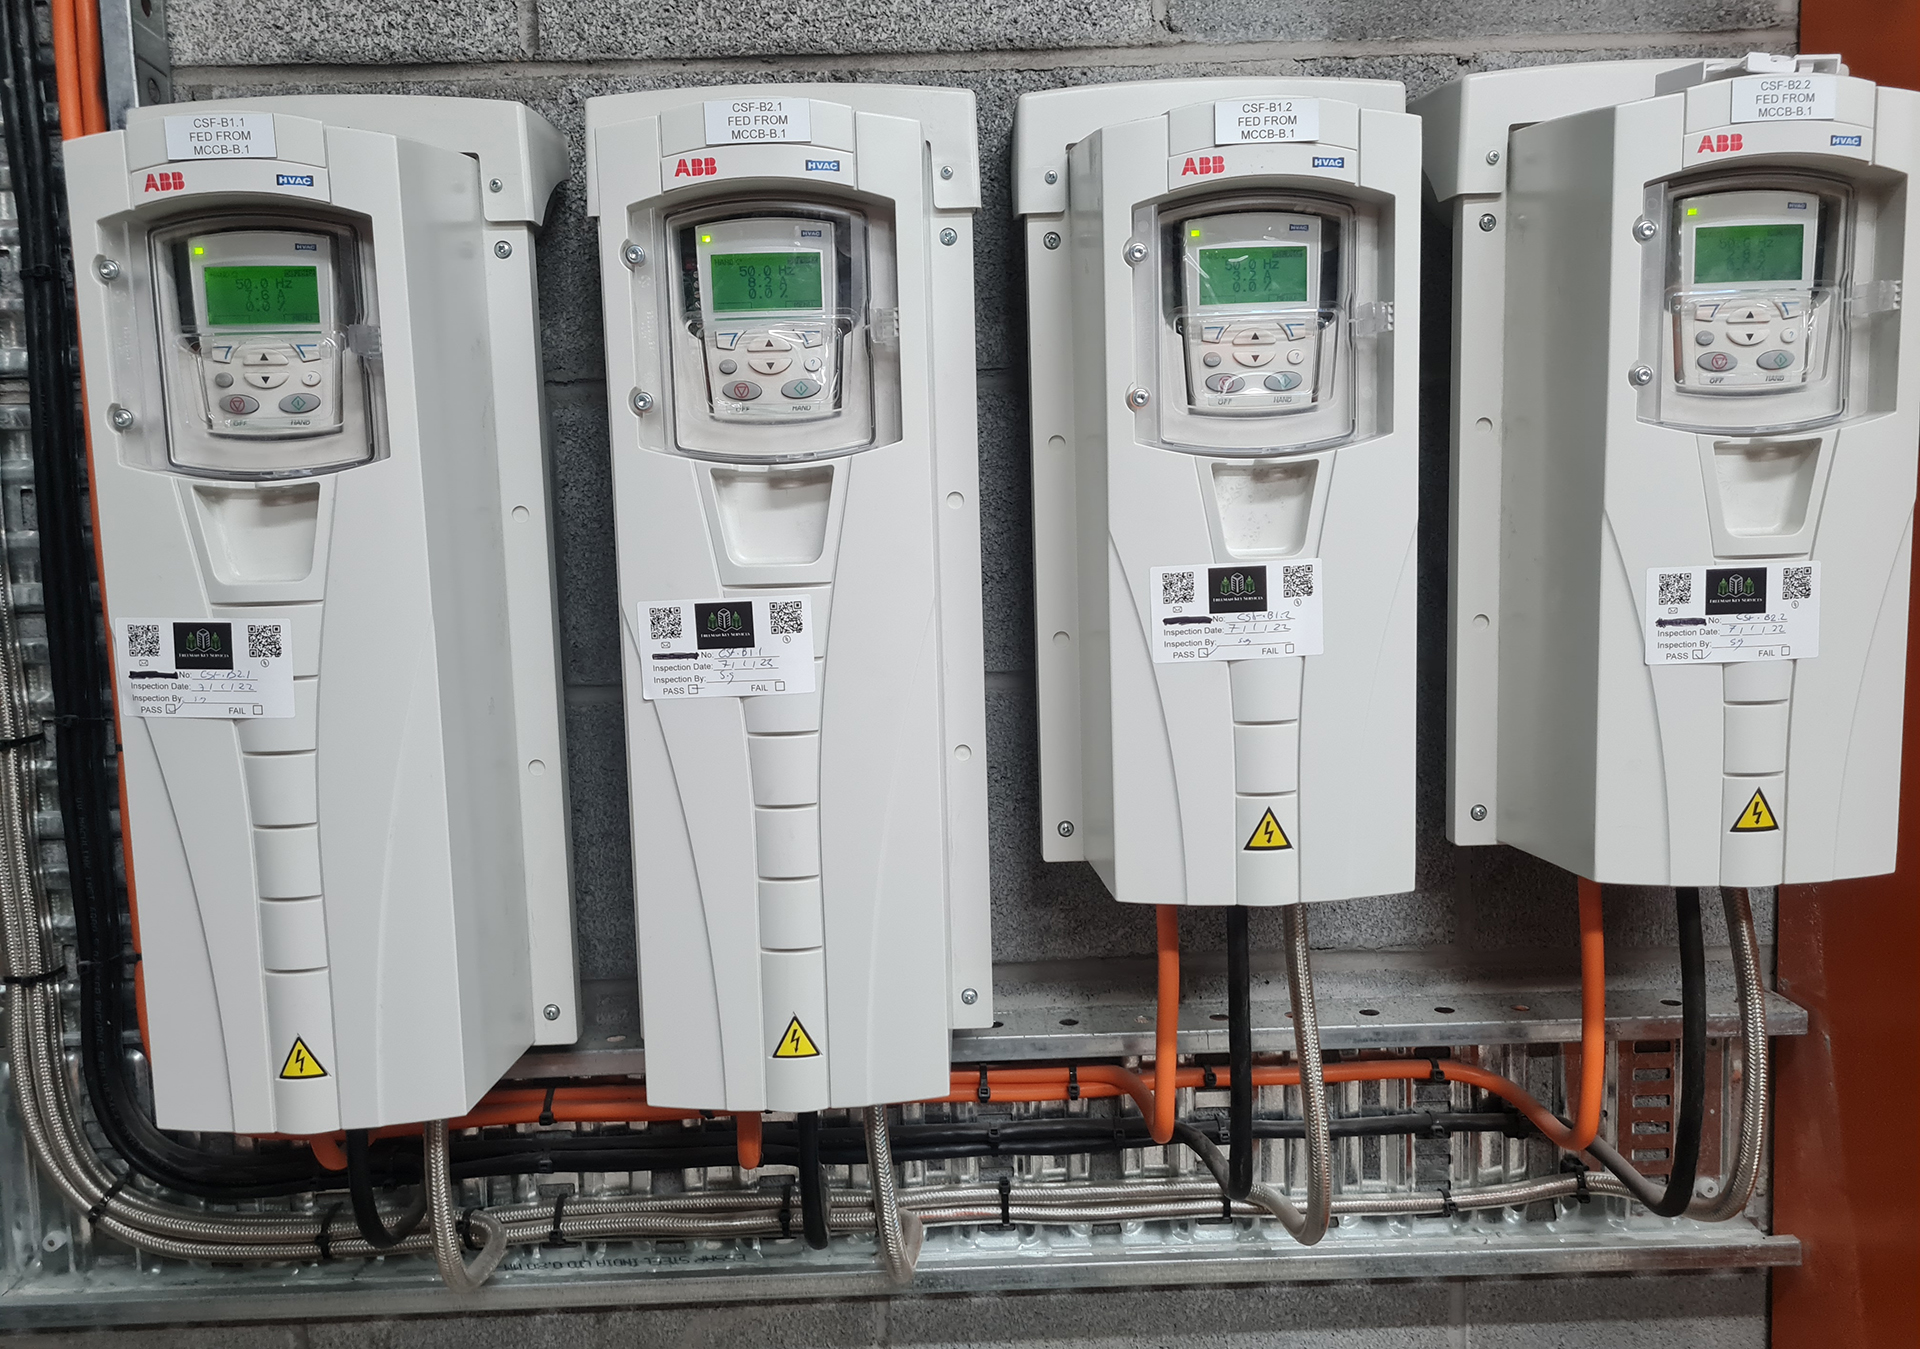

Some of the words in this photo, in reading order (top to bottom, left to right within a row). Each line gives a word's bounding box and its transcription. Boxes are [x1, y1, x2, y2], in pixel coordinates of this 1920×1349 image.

[1760, 80, 1811, 91] CSF-B2.2
[1756, 94, 1779, 105] FED
[1782, 92, 1815, 103] FROM
[732, 102, 782, 113] CSF-B2.1
[1242, 102, 1292, 113] CSF-B1.2
[1758, 106, 1812, 118] MCCB-B.1
[193, 117, 245, 129] CSF-B1.1
[728, 116, 751, 126] FED
[754, 116, 789, 126] FROM
[1238, 117, 1261, 127] FED
[1264, 116, 1297, 126] FROM
[190, 132, 212, 143] FED
[216, 130, 252, 142] FROM
[731, 129, 787, 139] MCCB-B.1
[1241, 129, 1295, 139] MCCB-B.1
[1697, 134, 1743, 153] ABB
[1832, 136, 1859, 145] HVAC
[194, 144, 250, 156] MCCB-B.1
[674, 158, 717, 177] ABB
[808, 161, 838, 170] HVAC
[1182, 156, 1225, 176] ABB
[1314, 158, 1343, 167] HVAC
[144, 172, 185, 193] ABB
[278, 176, 312, 186] HVAC
[1264, 259, 1280, 269] Hz
[739, 265, 772, 277] 50.0
[779, 265, 796, 275] Hz
[1233, 271, 1257, 281] 3.2
[235, 278, 269, 290] 50.0
[276, 278, 292, 289] Hz
[748, 277, 772, 288] 8.2
[1233, 282, 1257, 293] 0.0
[245, 290, 270, 301] 7.6
[749, 288, 773, 299] 0.0
[246, 300, 271, 312] 0.0
[1164, 628, 1203, 636] Inspection
[1204, 626, 1225, 635] Date:
[1657, 630, 1697, 638] Inspection
[1700, 628, 1720, 636] Date:
[1164, 640, 1203, 648] Inspection
[1204, 639, 1217, 647] By:
[1700, 640, 1712, 649] By:
[1173, 651, 1195, 659] PASS
[1666, 652, 1689, 660] PASS
[1758, 649, 1775, 657] FAIL
[653, 664, 692, 672] Inspection
[694, 663, 714, 671] Date:
[654, 676, 693, 684] Inspection
[694, 675, 706, 684] By:
[131, 683, 169, 691] Inspection
[663, 687, 685, 695] PASS
[751, 684, 769, 692] FAIL
[132, 694, 170, 703] Inspection
[172, 695, 184, 703] By:
[596, 1257, 638, 1268] INDIA
